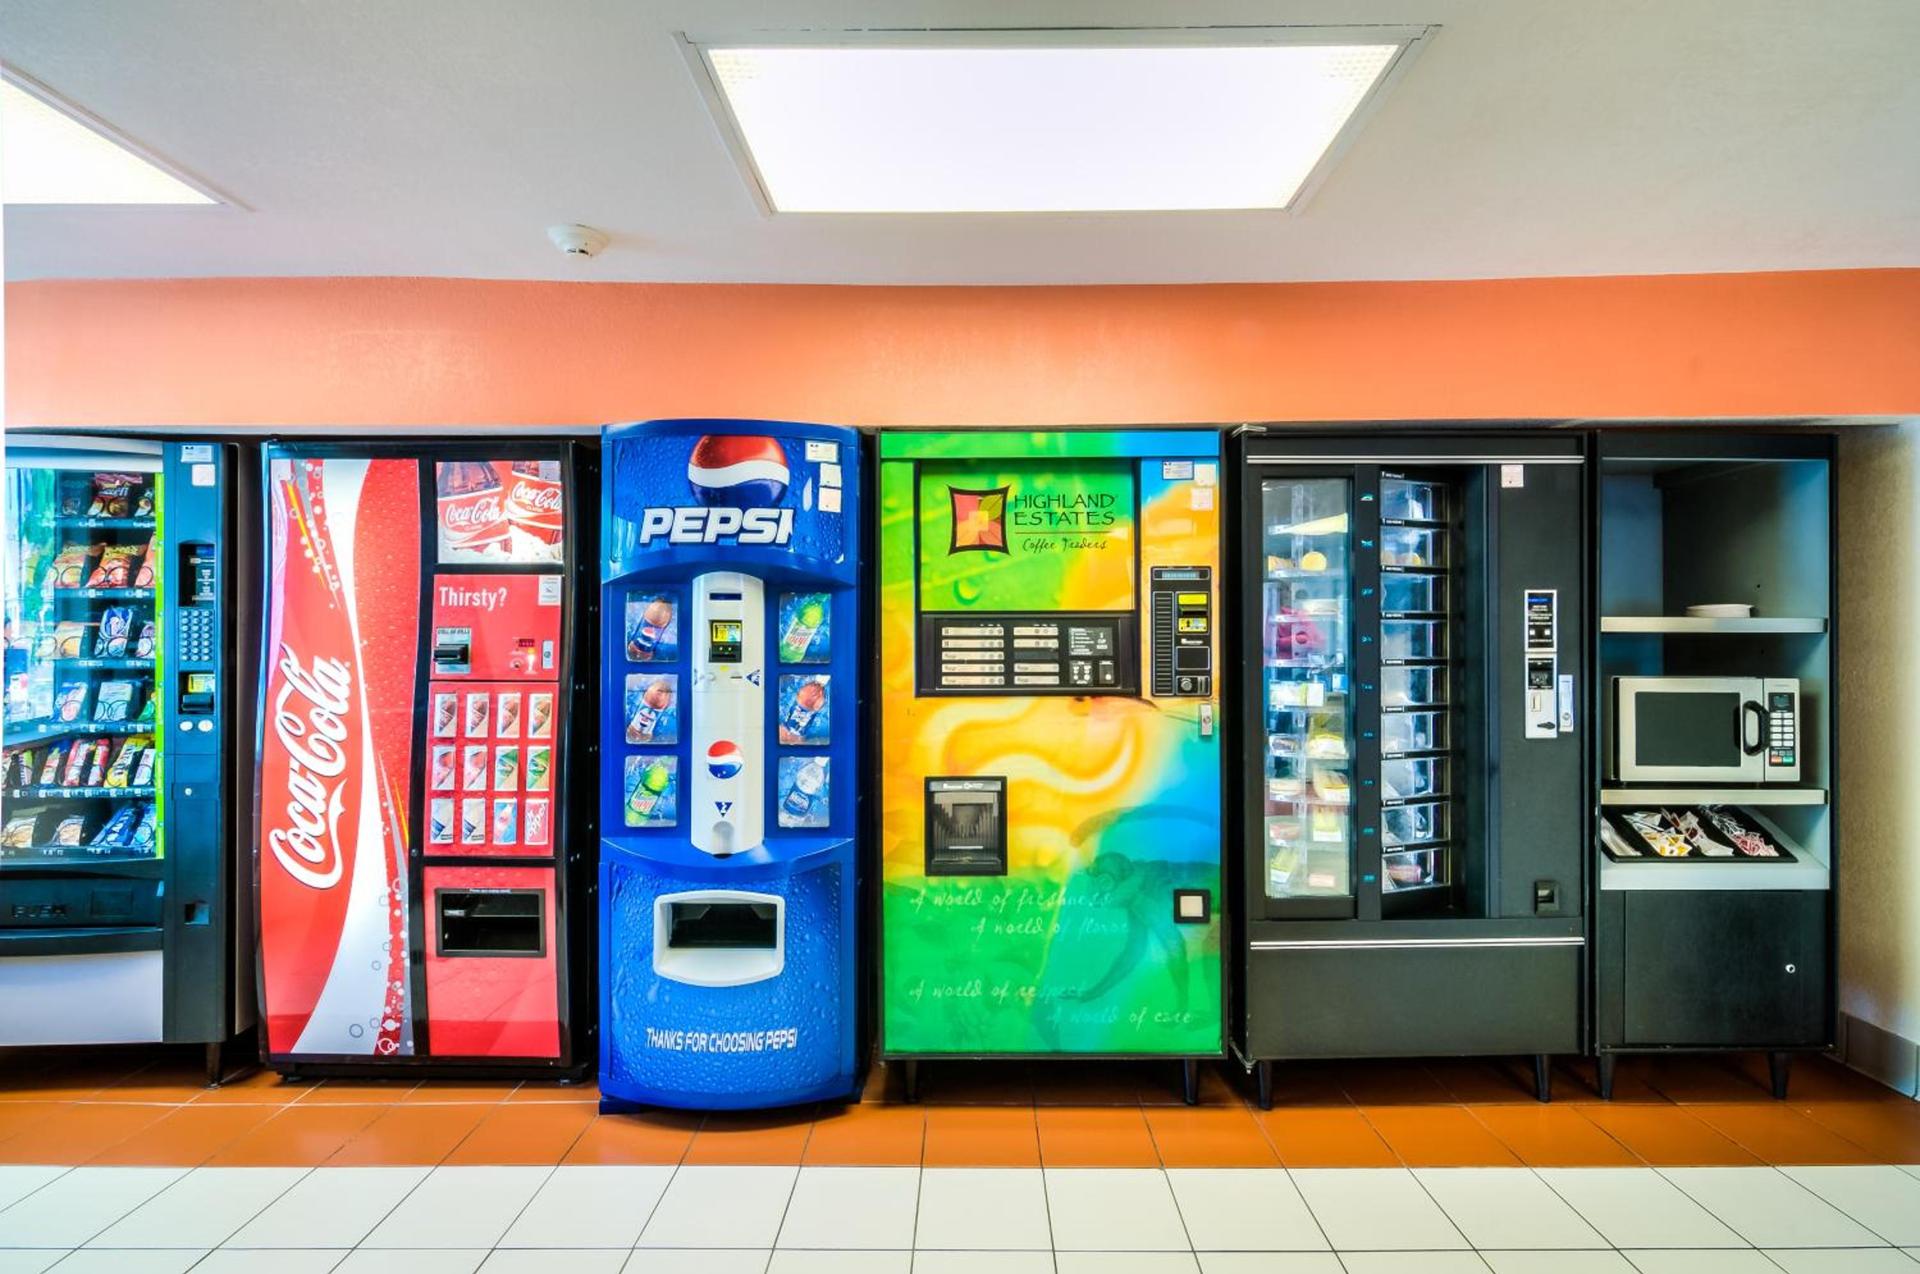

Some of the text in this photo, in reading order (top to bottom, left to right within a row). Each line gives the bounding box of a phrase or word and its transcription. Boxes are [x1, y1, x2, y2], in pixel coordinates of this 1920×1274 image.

[1014, 494, 1115, 508] HIGHLAND
[640, 508, 794, 544] PEPSI
[1014, 512, 1115, 526] ESTATES
[1022, 537, 1108, 554] Coffee Traders
[439, 586, 508, 611] Thirsty?
[268, 641, 353, 891] Coca-Cola
[934, 887, 983, 908] world
[991, 889, 1011, 913] of
[994, 917, 1043, 935] world
[932, 978, 982, 998] world
[991, 979, 1009, 1005] of
[1129, 1006, 1148, 1031] of
[1153, 1011, 1193, 1024] care
[646, 1027, 798, 1053] THANKS FOR CHOOSING PEPSI
